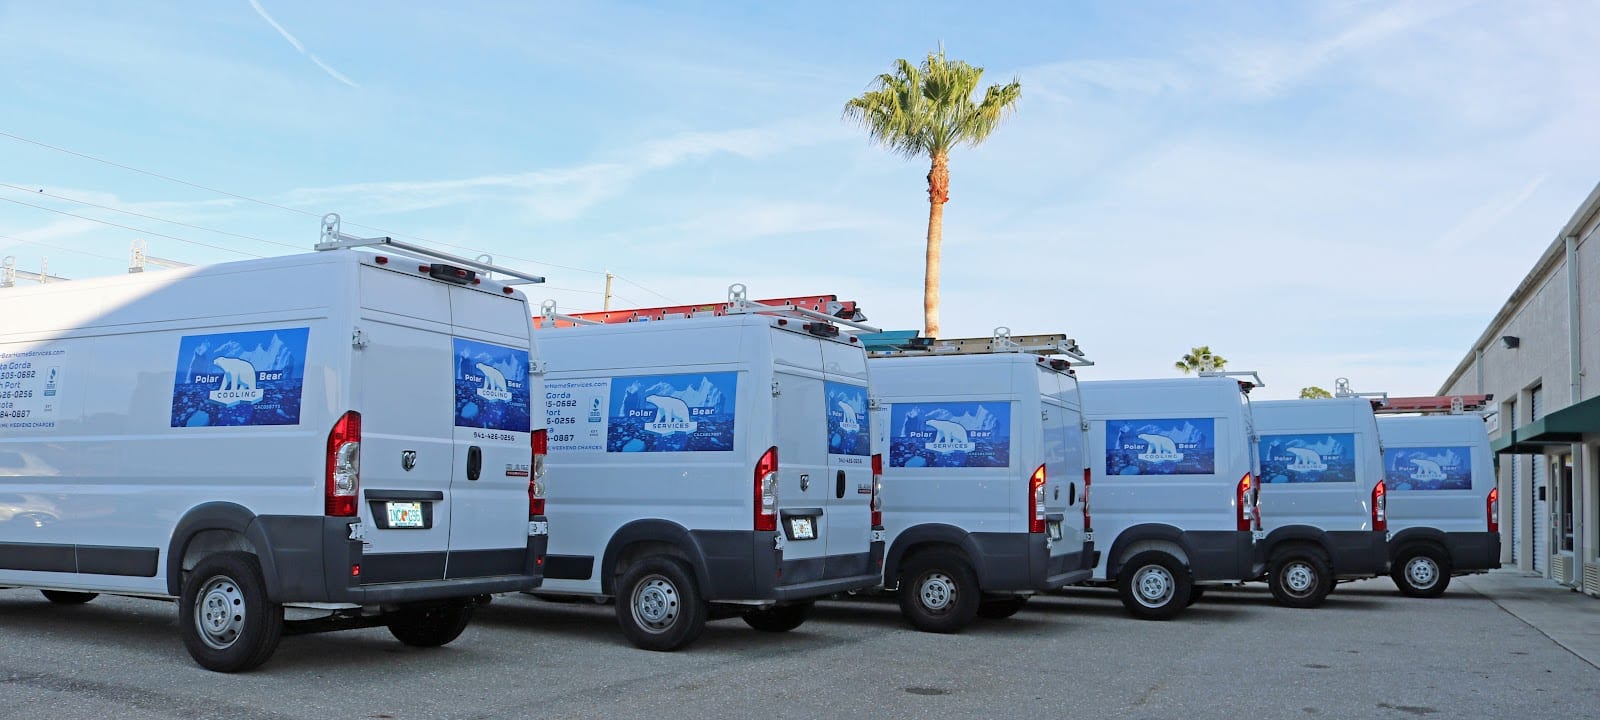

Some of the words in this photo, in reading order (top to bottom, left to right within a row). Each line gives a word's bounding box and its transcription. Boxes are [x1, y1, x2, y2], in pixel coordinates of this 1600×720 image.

[9, 361, 31, 370] Gorda
[195, 375, 219, 384] Polar
[259, 372, 283, 381] Bear
[465, 374, 483, 383] Polar
[507, 380, 522, 389] Bear
[5, 381, 21, 389] Port
[217, 391, 256, 399] COOLING
[482, 390, 508, 399] COOLING
[546, 391, 571, 400] Gorda
[629, 410, 653, 418] Polar
[692, 408, 715, 416] Bear
[910, 431, 933, 439] Polar
[970, 430, 991, 438] Bear
